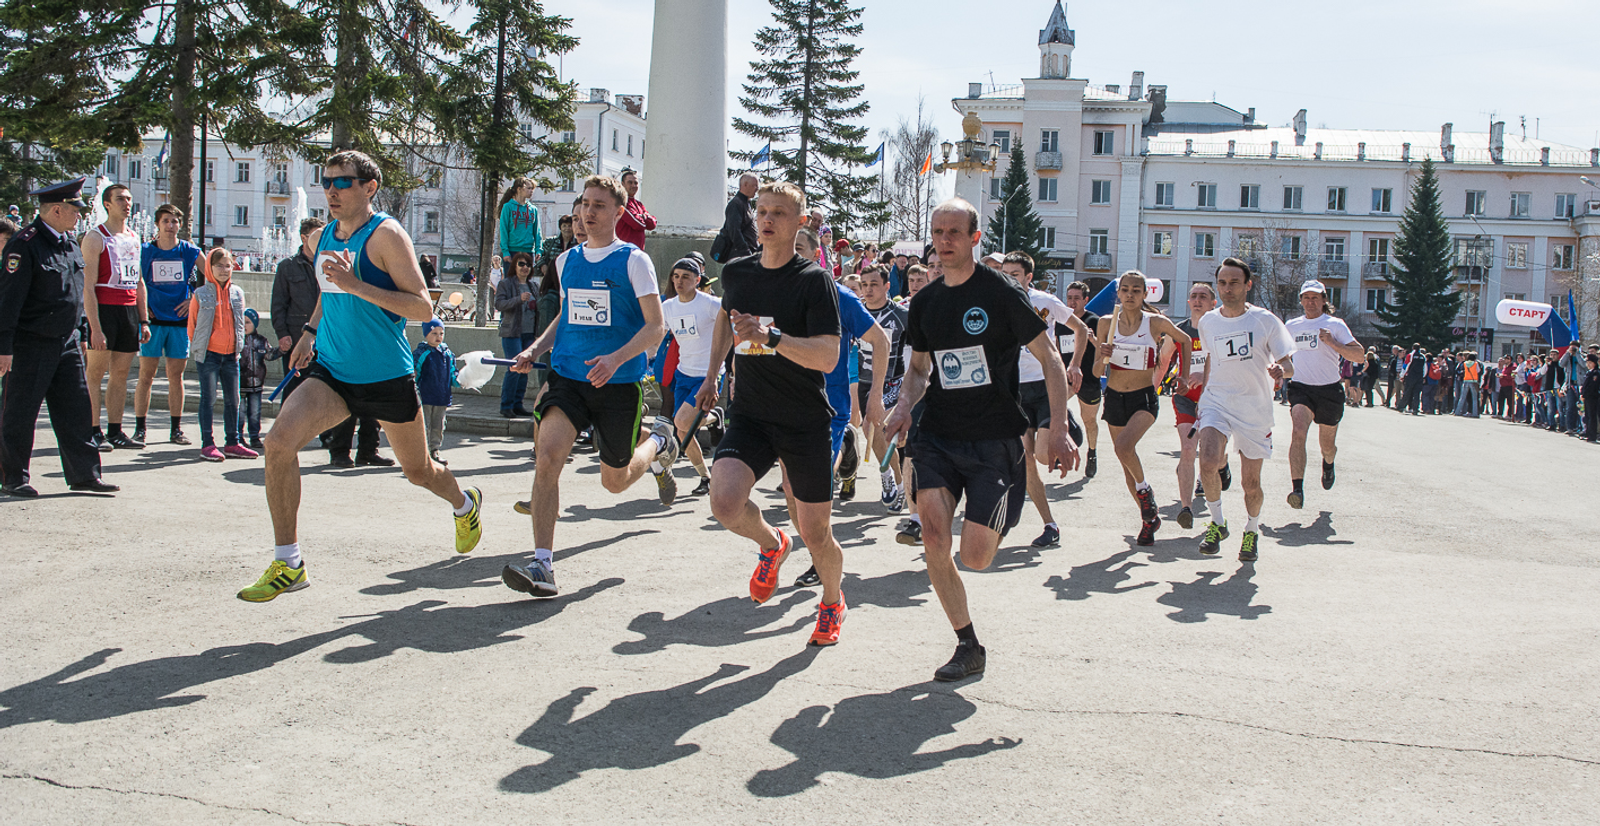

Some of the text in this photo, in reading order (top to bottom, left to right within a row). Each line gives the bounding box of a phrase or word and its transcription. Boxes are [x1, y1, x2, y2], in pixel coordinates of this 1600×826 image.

[511, 211, 535, 220] PARS
[125, 265, 136, 277] 16
[1509, 307, 1546, 319] СТАРТ
[1225, 339, 1237, 357] 1
[1123, 355, 1130, 366] 1
